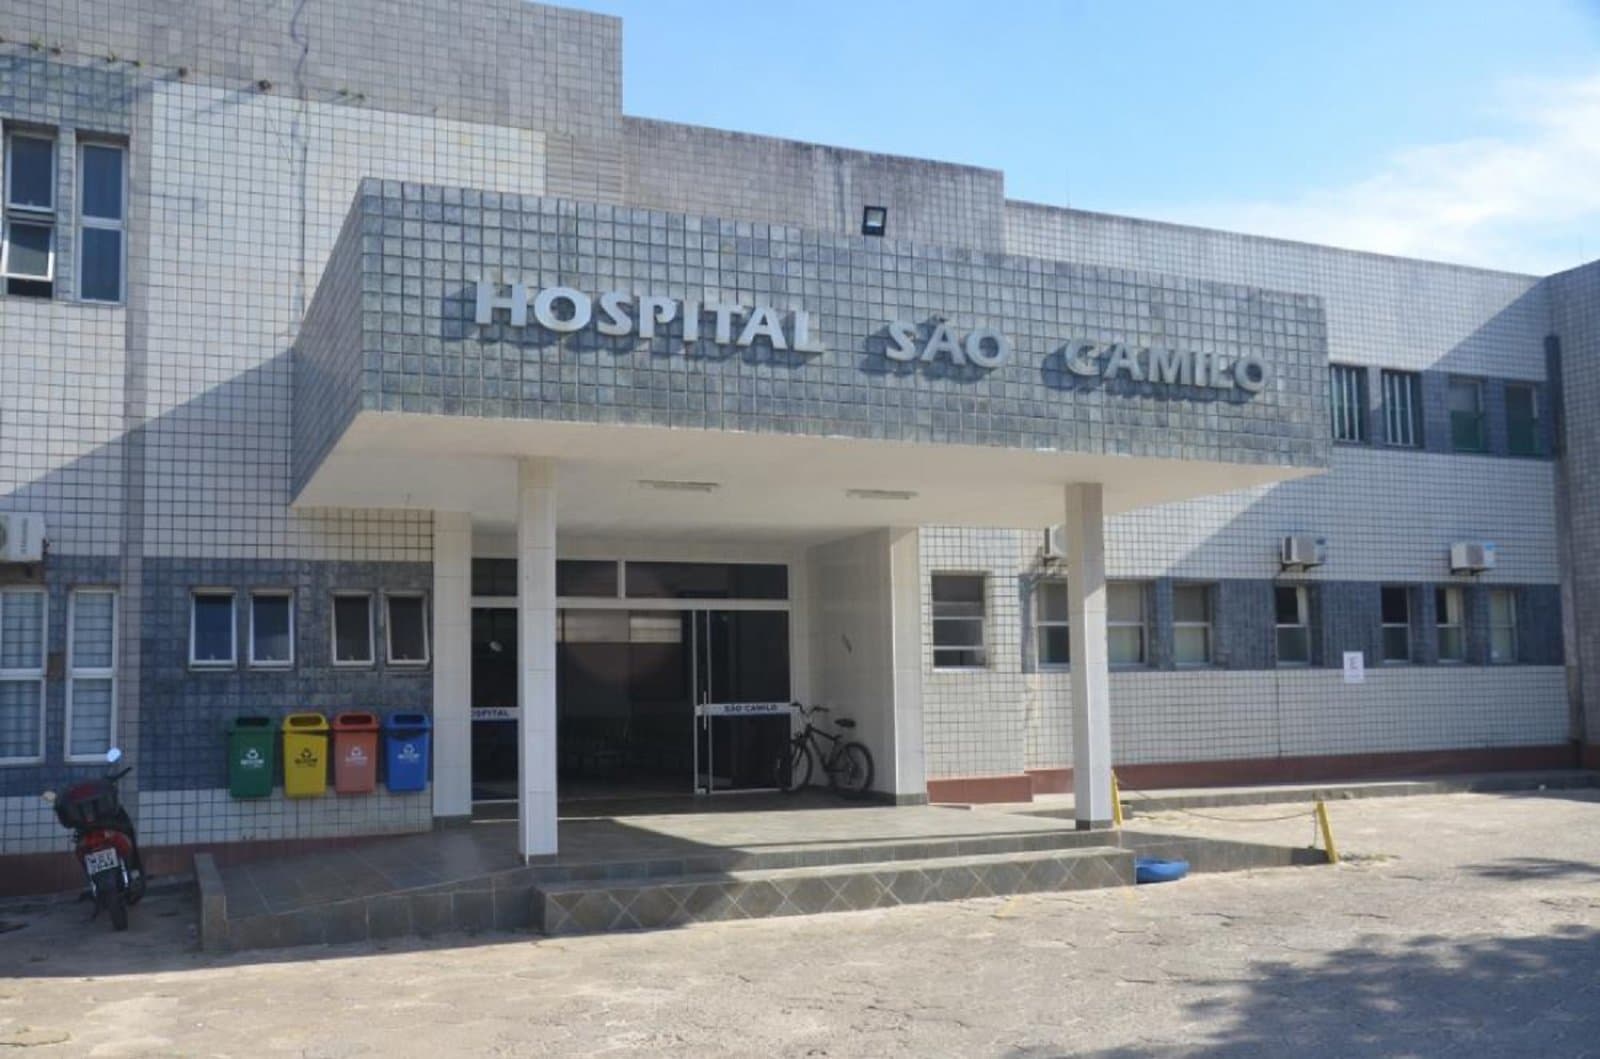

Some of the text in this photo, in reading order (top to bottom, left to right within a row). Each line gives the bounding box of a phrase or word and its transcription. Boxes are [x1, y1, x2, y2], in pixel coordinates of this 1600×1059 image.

[474, 279, 1270, 393] HOSPITAL SÃO CAMILO
[744, 703, 778, 712] CAMILO
